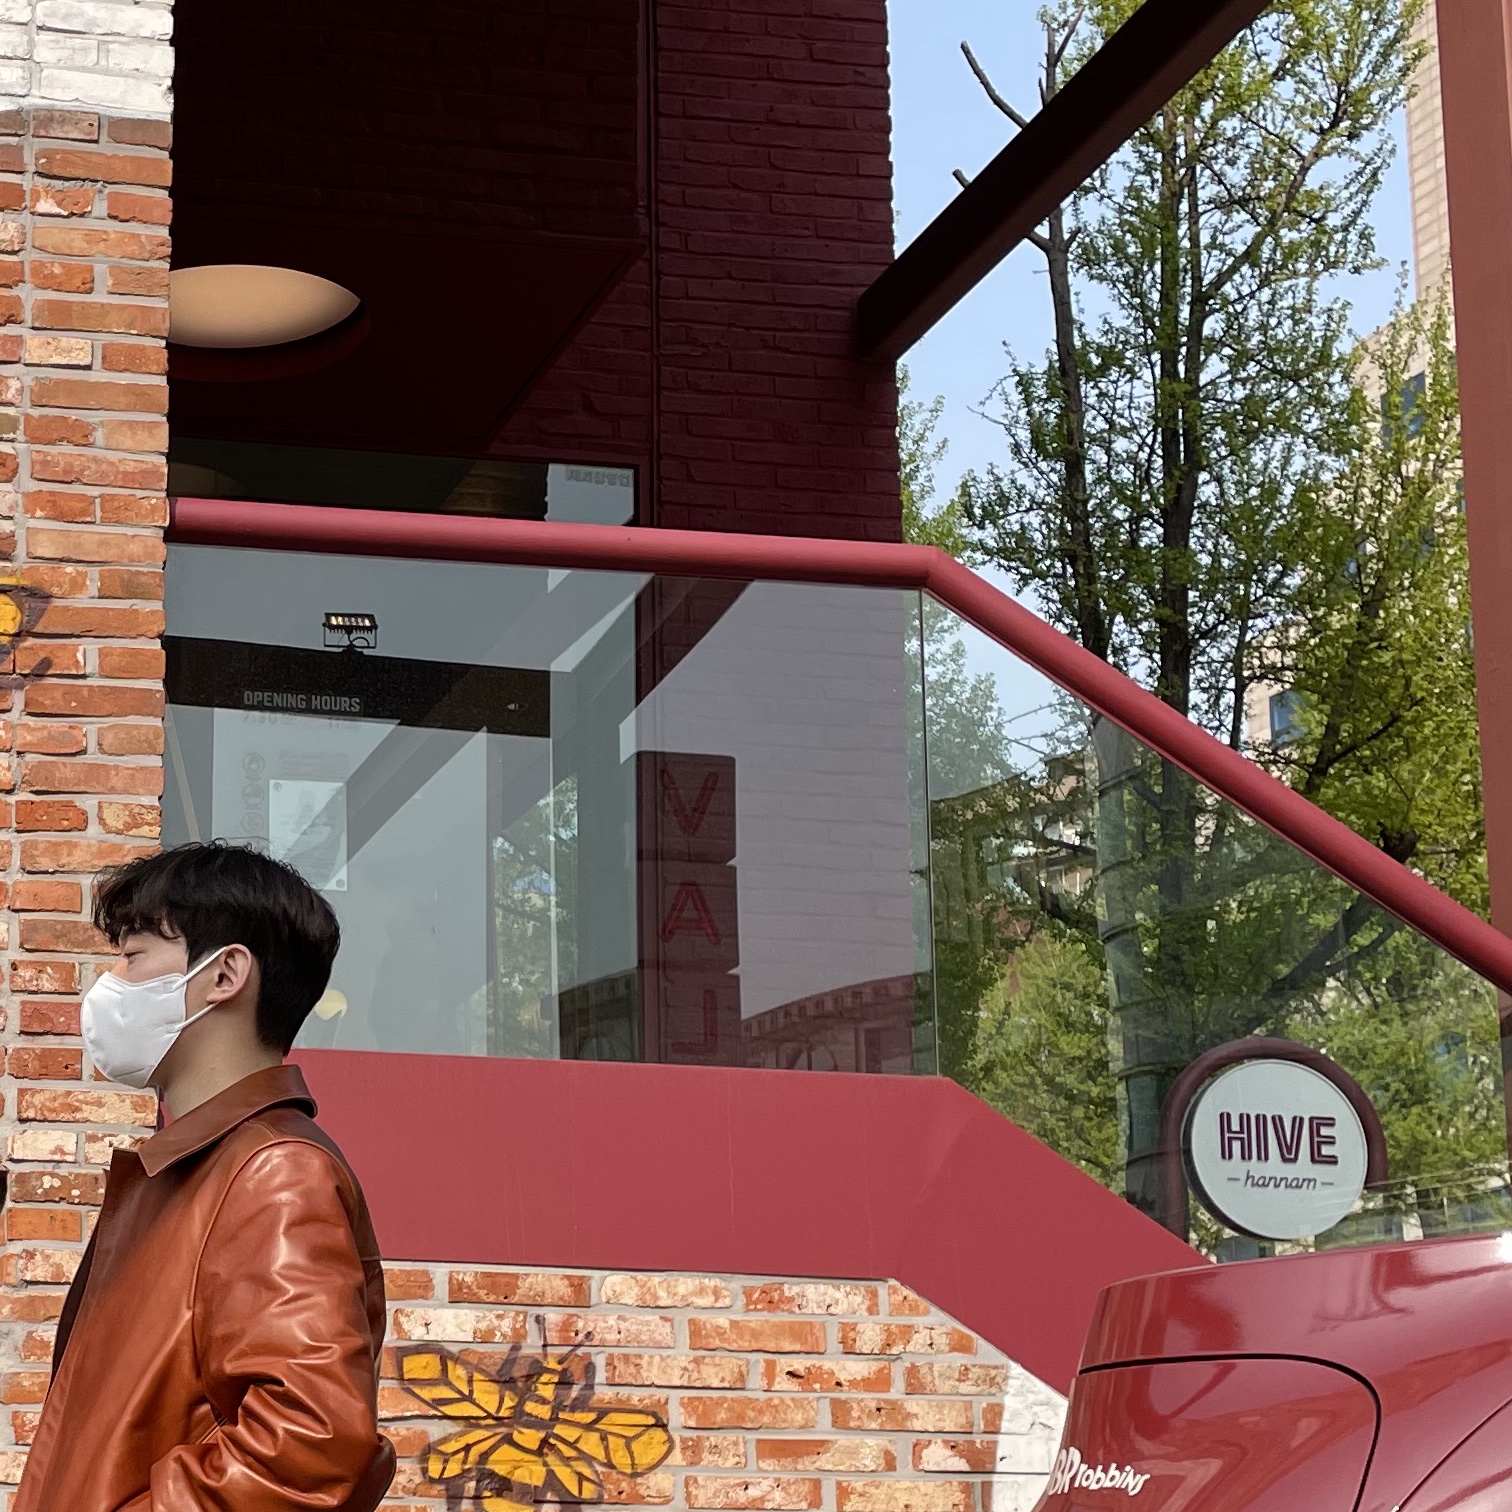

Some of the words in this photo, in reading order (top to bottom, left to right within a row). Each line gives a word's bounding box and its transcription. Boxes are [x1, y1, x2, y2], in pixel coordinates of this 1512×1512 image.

[243, 690, 307, 709] OPENING
[311, 694, 361, 713] HOURS
[1219, 1111, 1339, 1166] HIVE
[1244, 1169, 1318, 1191] hannam
